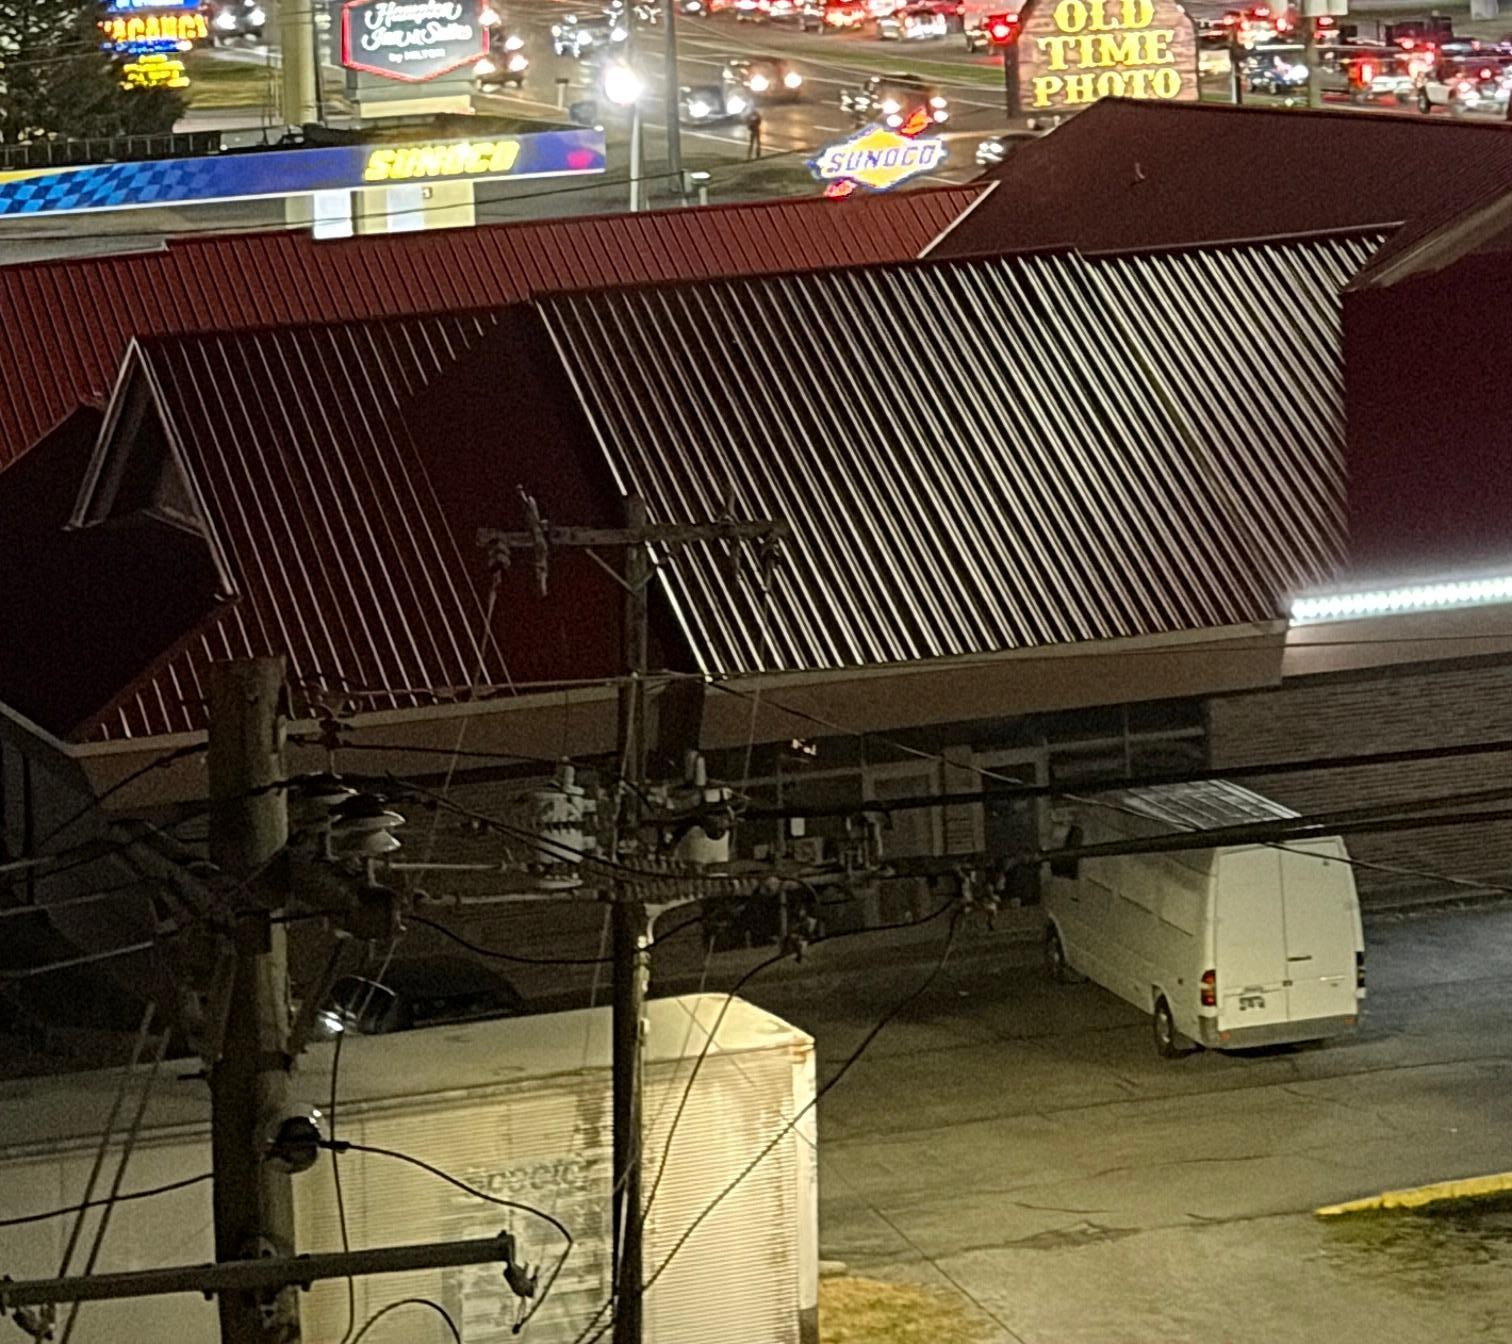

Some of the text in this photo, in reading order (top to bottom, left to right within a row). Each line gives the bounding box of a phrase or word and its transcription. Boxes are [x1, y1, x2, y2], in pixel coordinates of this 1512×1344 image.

[364, 0, 463, 30] Hampton
[1037, 29, 1175, 71] TIME
[1032, 67, 1182, 107] PHOTO
[364, 140, 520, 181] SUNOCO
[827, 145, 936, 173] SUNOCO
